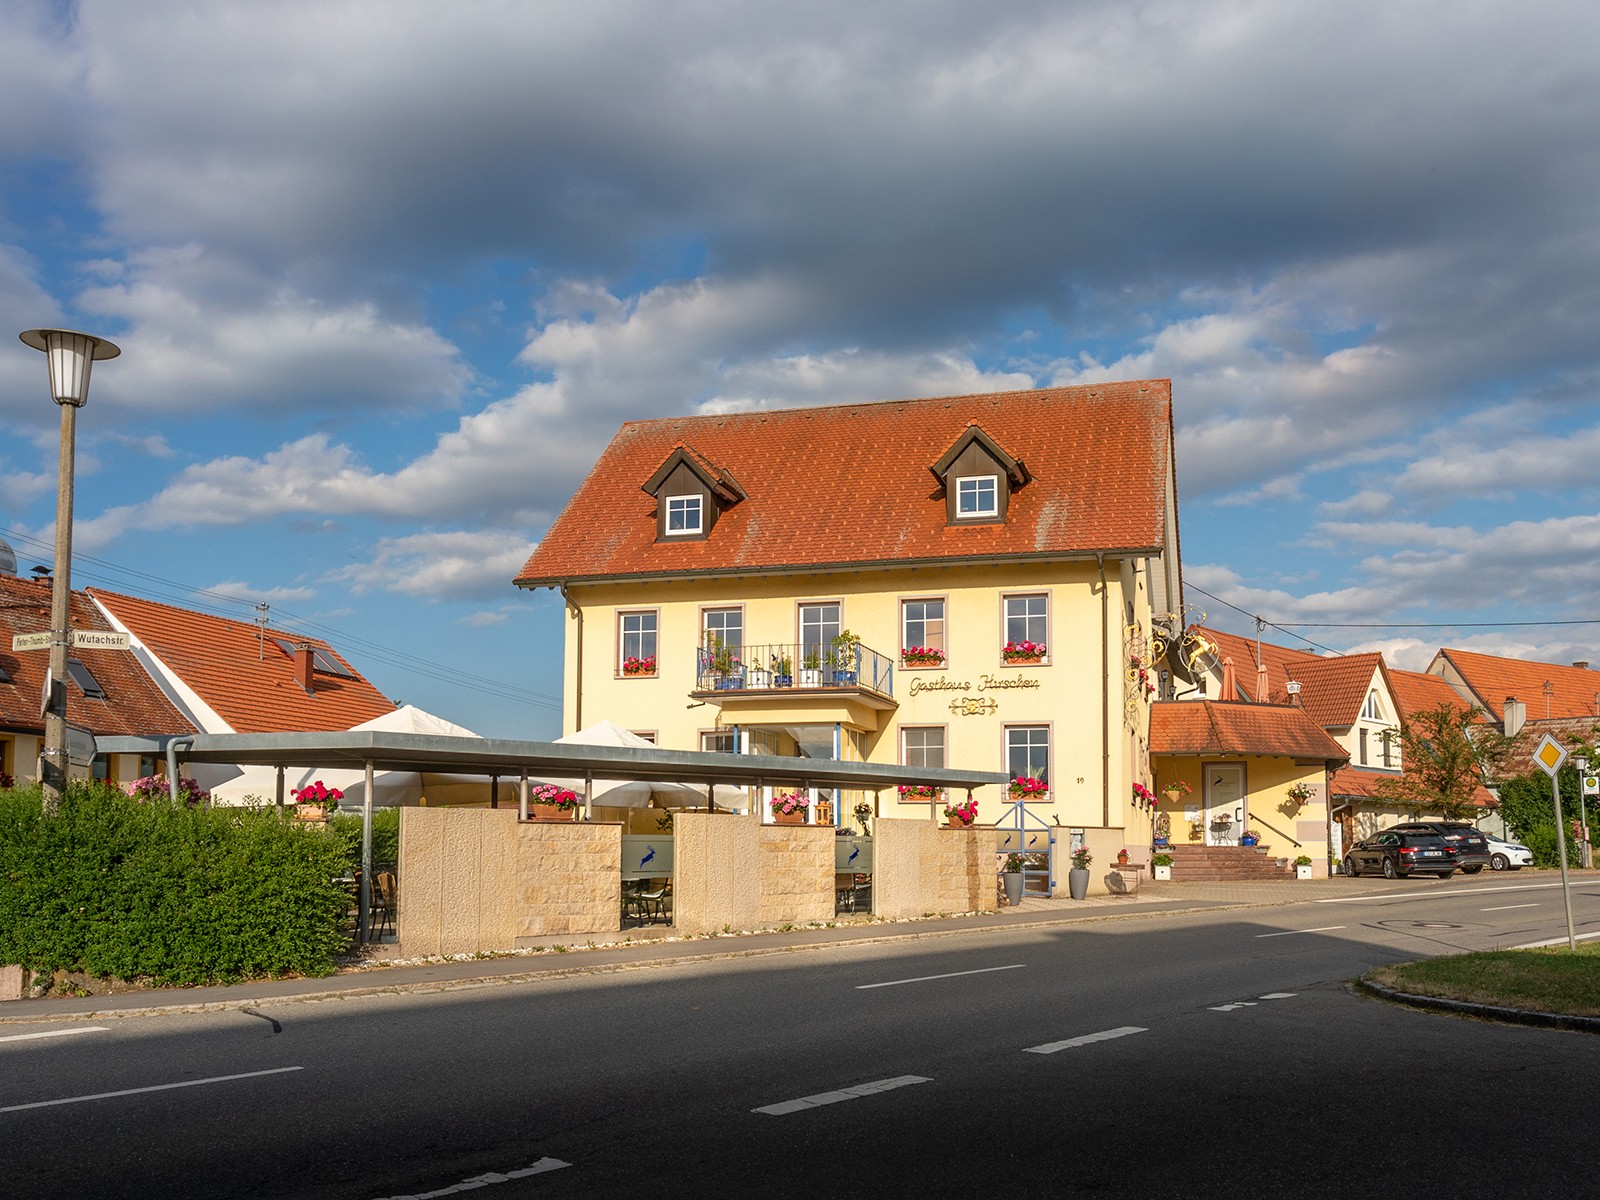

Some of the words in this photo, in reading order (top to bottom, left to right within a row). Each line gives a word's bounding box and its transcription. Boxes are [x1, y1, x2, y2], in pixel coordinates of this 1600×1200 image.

[77, 633, 124, 645] Wutachstr.
[909, 676, 971, 697] Gasthaus
[978, 673, 1040, 692] Hirschen
